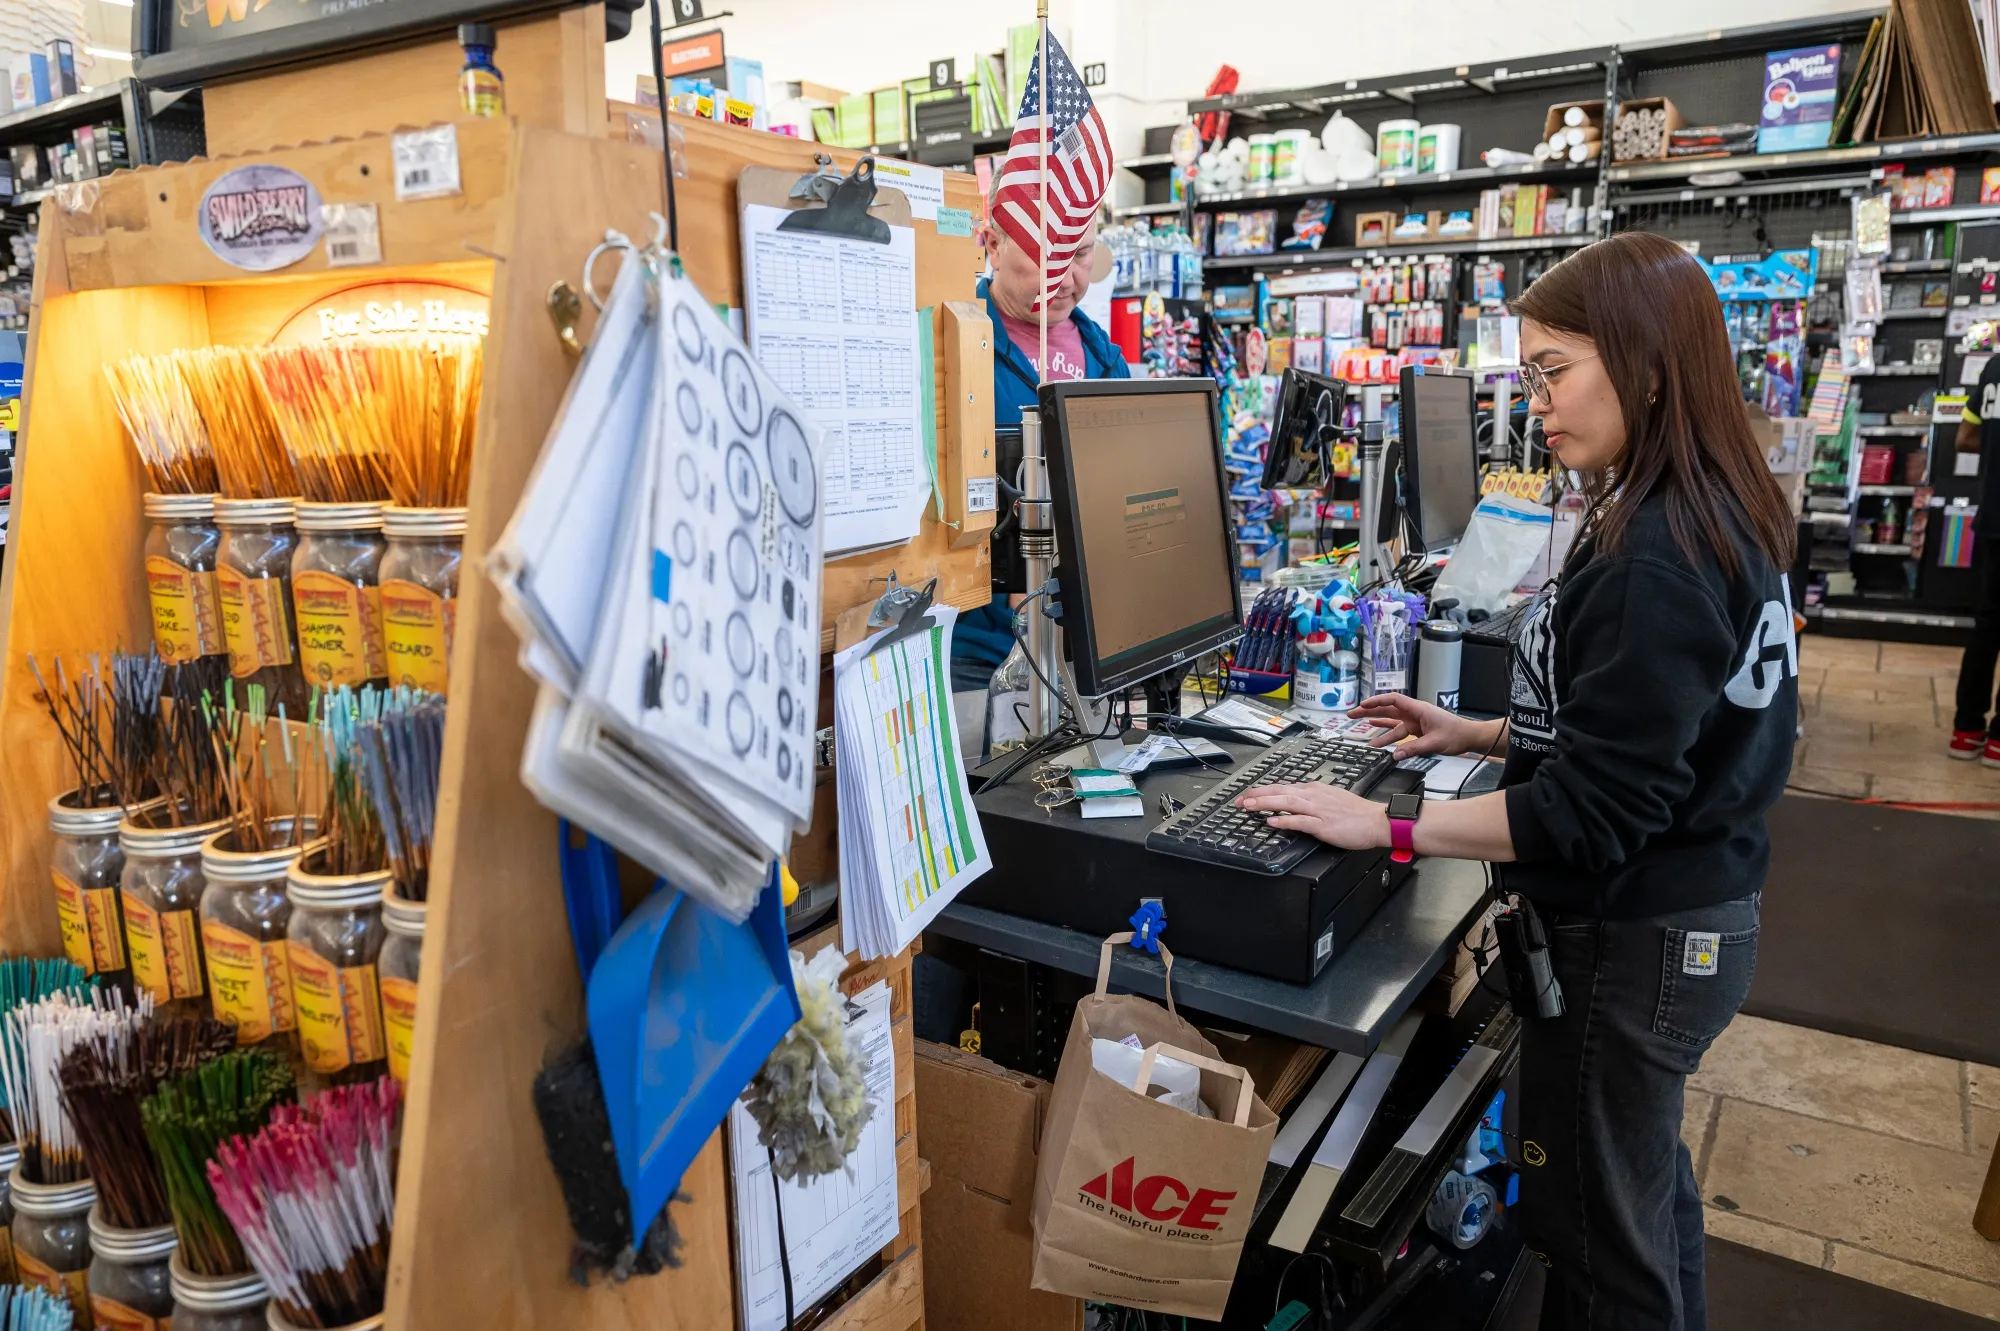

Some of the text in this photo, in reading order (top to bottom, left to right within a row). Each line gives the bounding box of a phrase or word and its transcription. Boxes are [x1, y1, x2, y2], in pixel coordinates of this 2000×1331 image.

[936, 62, 949, 86] 9
[1085, 64, 1105, 84] 10
[1767, 54, 1826, 80] Balloon
[209, 191, 258, 241] WILD
[258, 186, 307, 229] BERRY
[317, 299, 490, 341] For Sale Here
[1172, 650, 1186, 662] DELL
[1517, 711, 1550, 728] soul.
[1079, 1155, 1238, 1231] ACE
[1077, 1192, 1213, 1242] The helpful place.
[1088, 1261, 1180, 1286] www.acehardware.com
